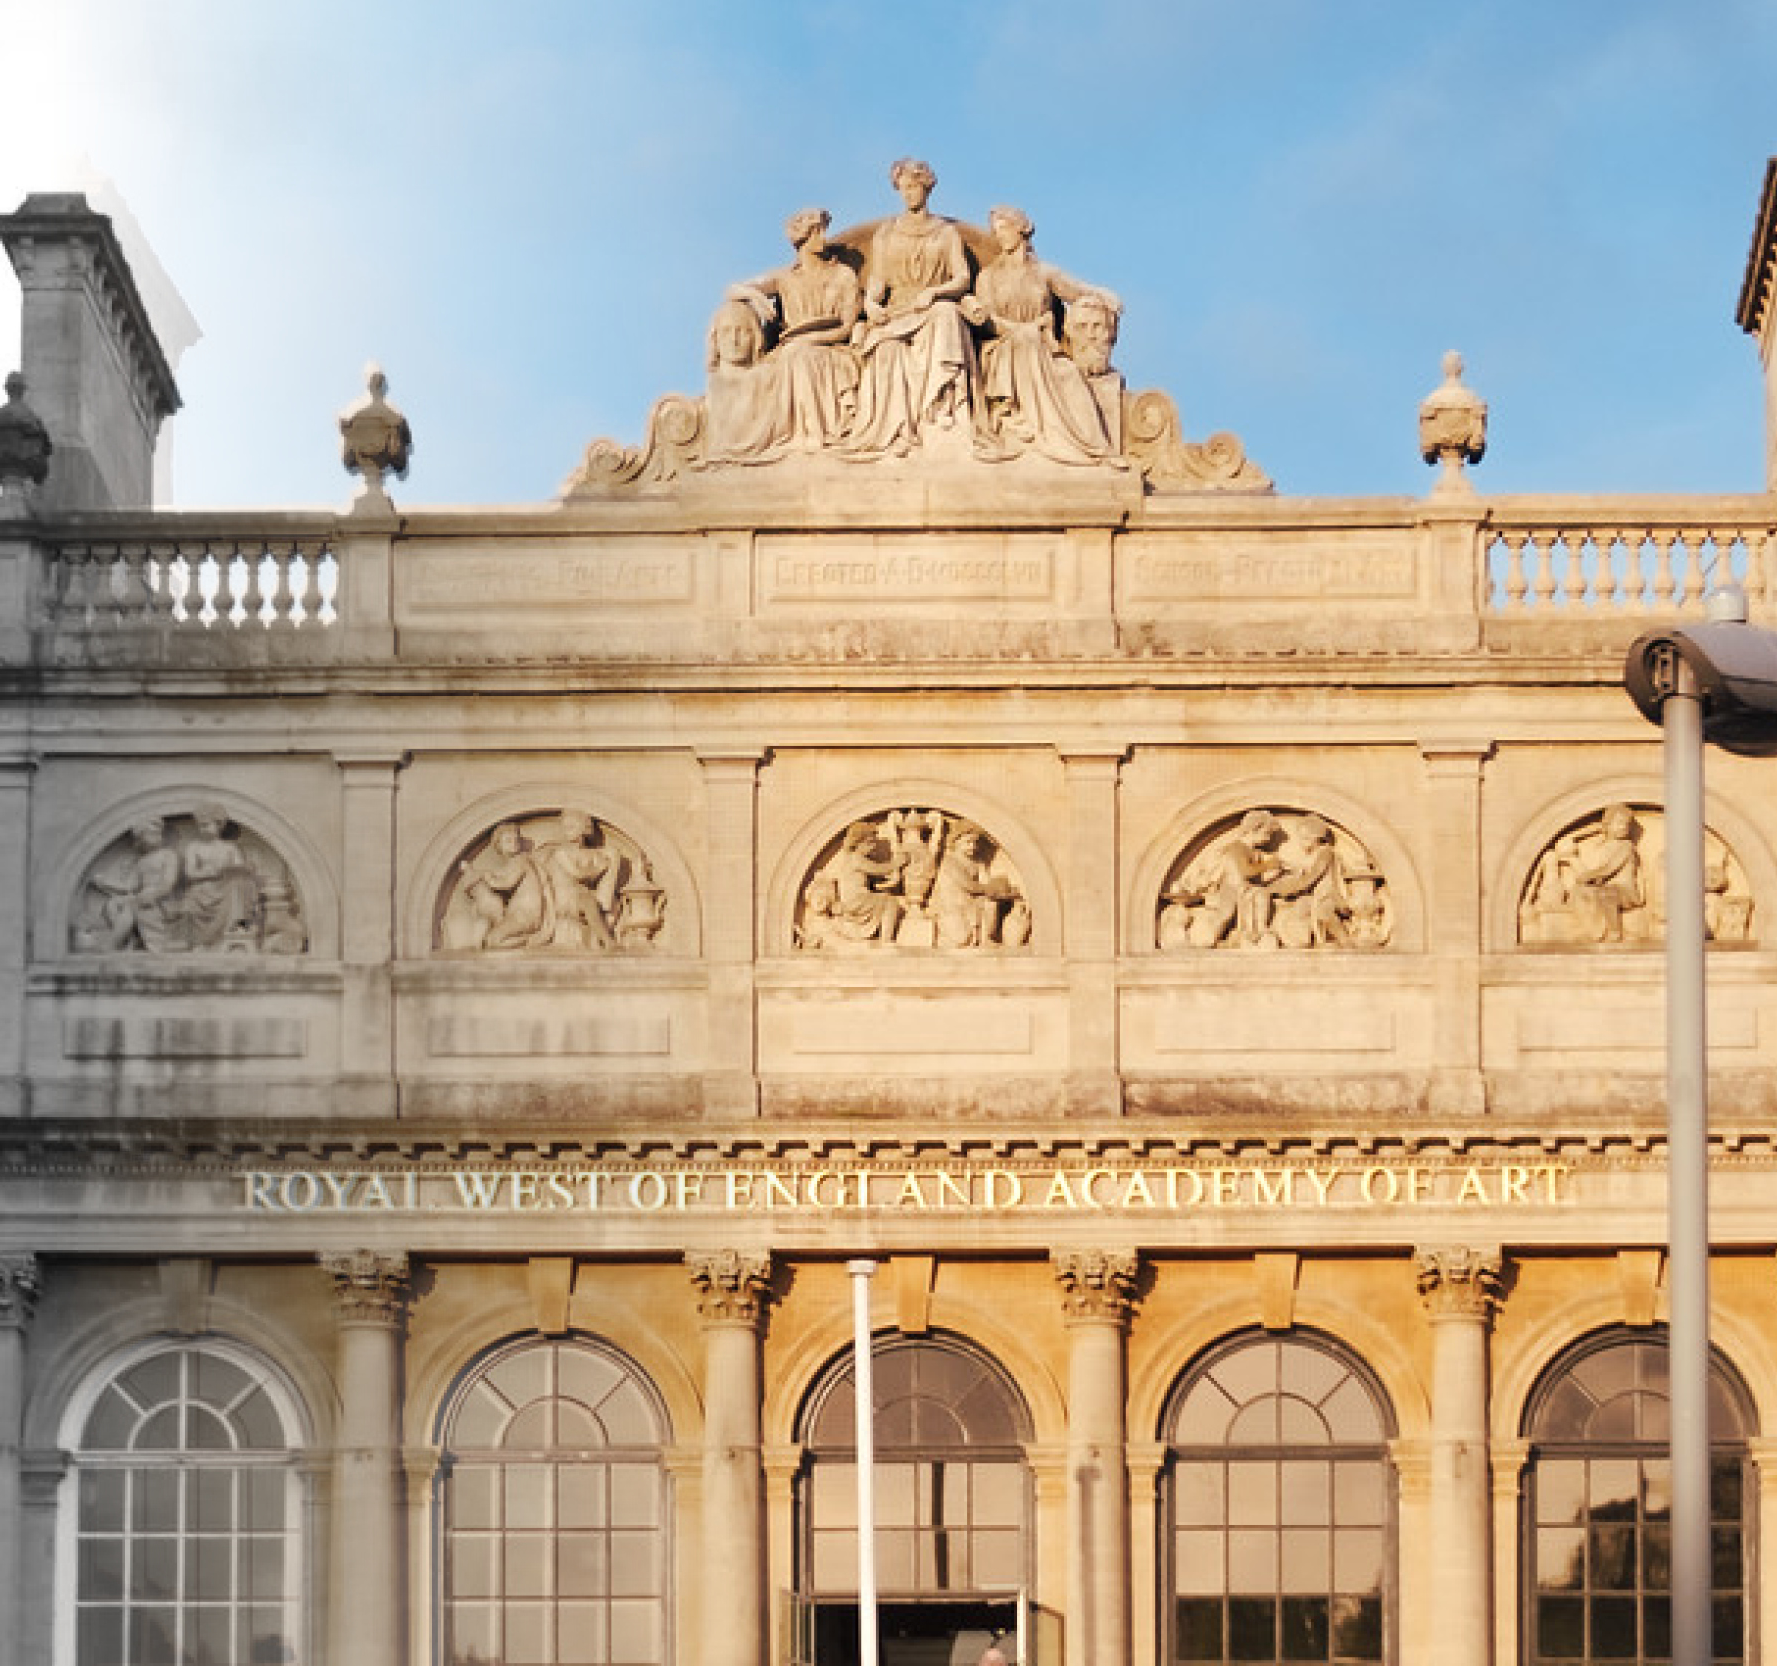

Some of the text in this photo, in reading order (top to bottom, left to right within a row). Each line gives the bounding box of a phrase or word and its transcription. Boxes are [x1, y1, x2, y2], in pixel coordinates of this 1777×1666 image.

[244, 1165, 1570, 1211] ROYAL WEST OF ENGLAND ACADEMY OF ART
